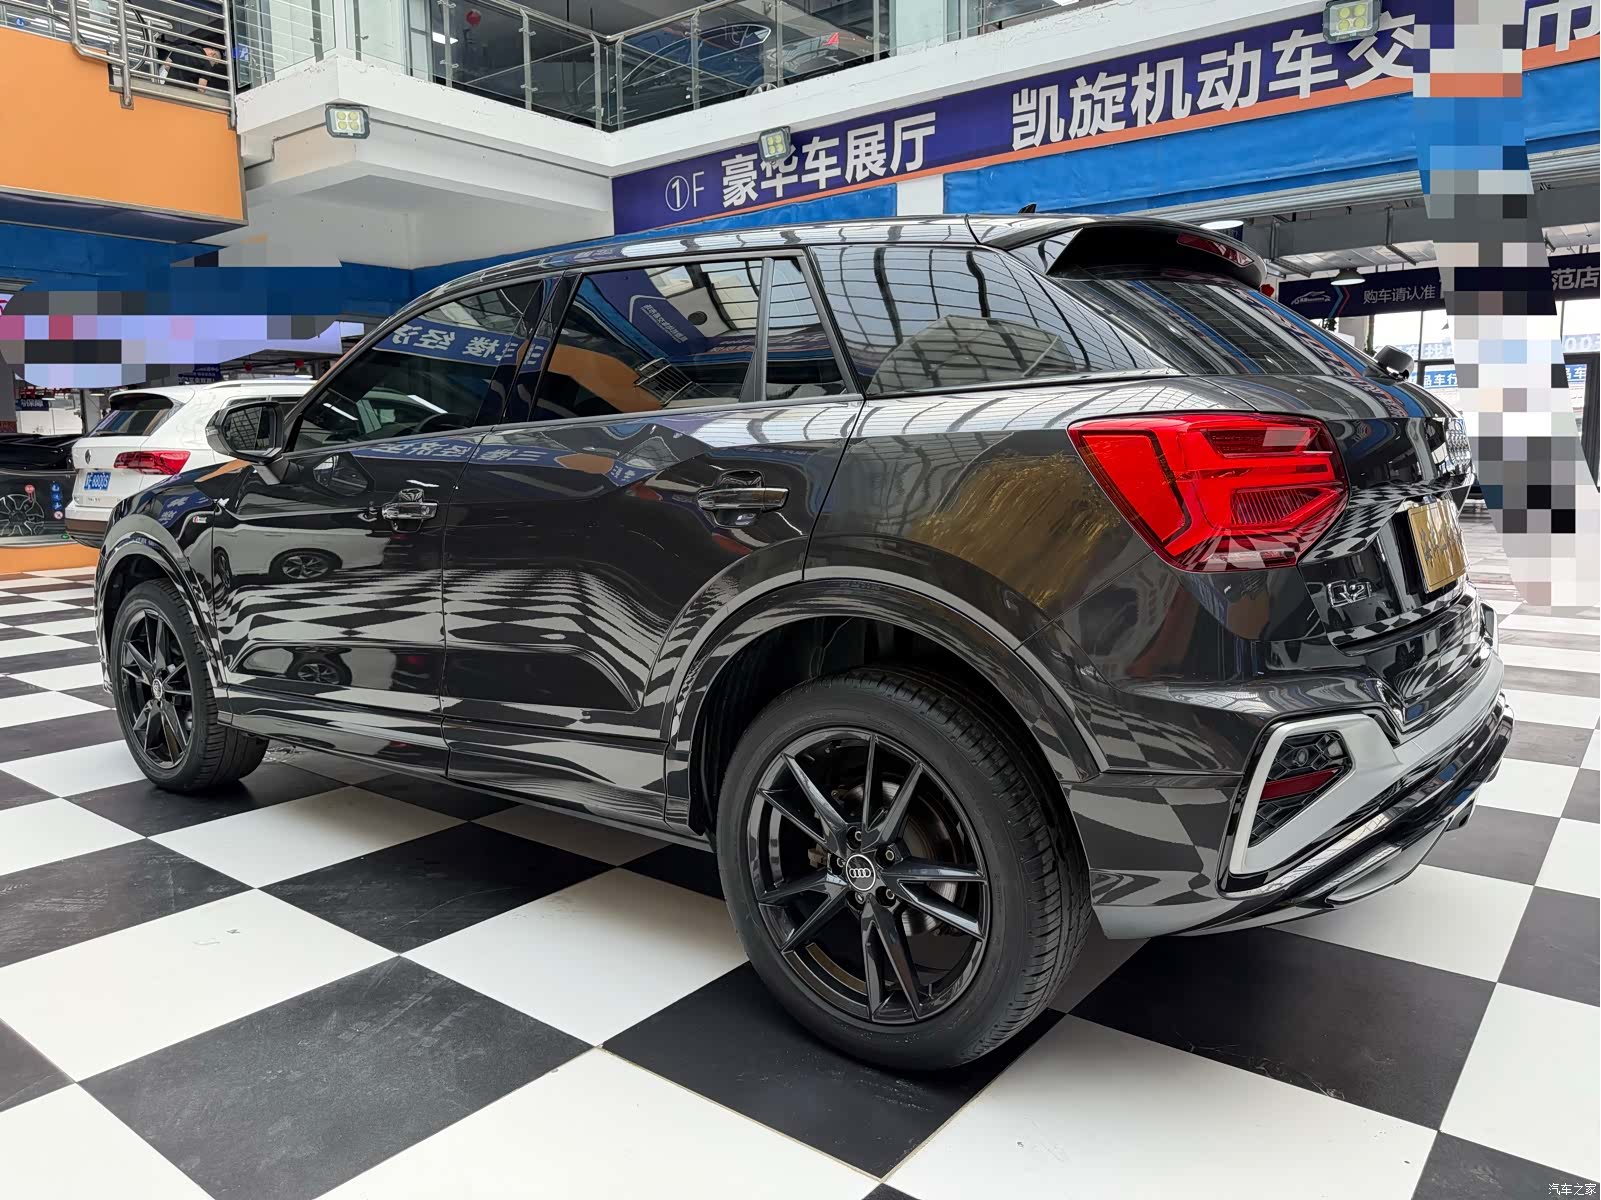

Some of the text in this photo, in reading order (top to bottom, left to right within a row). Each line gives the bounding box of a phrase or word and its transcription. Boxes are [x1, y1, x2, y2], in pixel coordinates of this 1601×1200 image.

[721, 112, 936, 208] 豪华车展厅
[1363, 284, 1436, 305] 购车请认准
